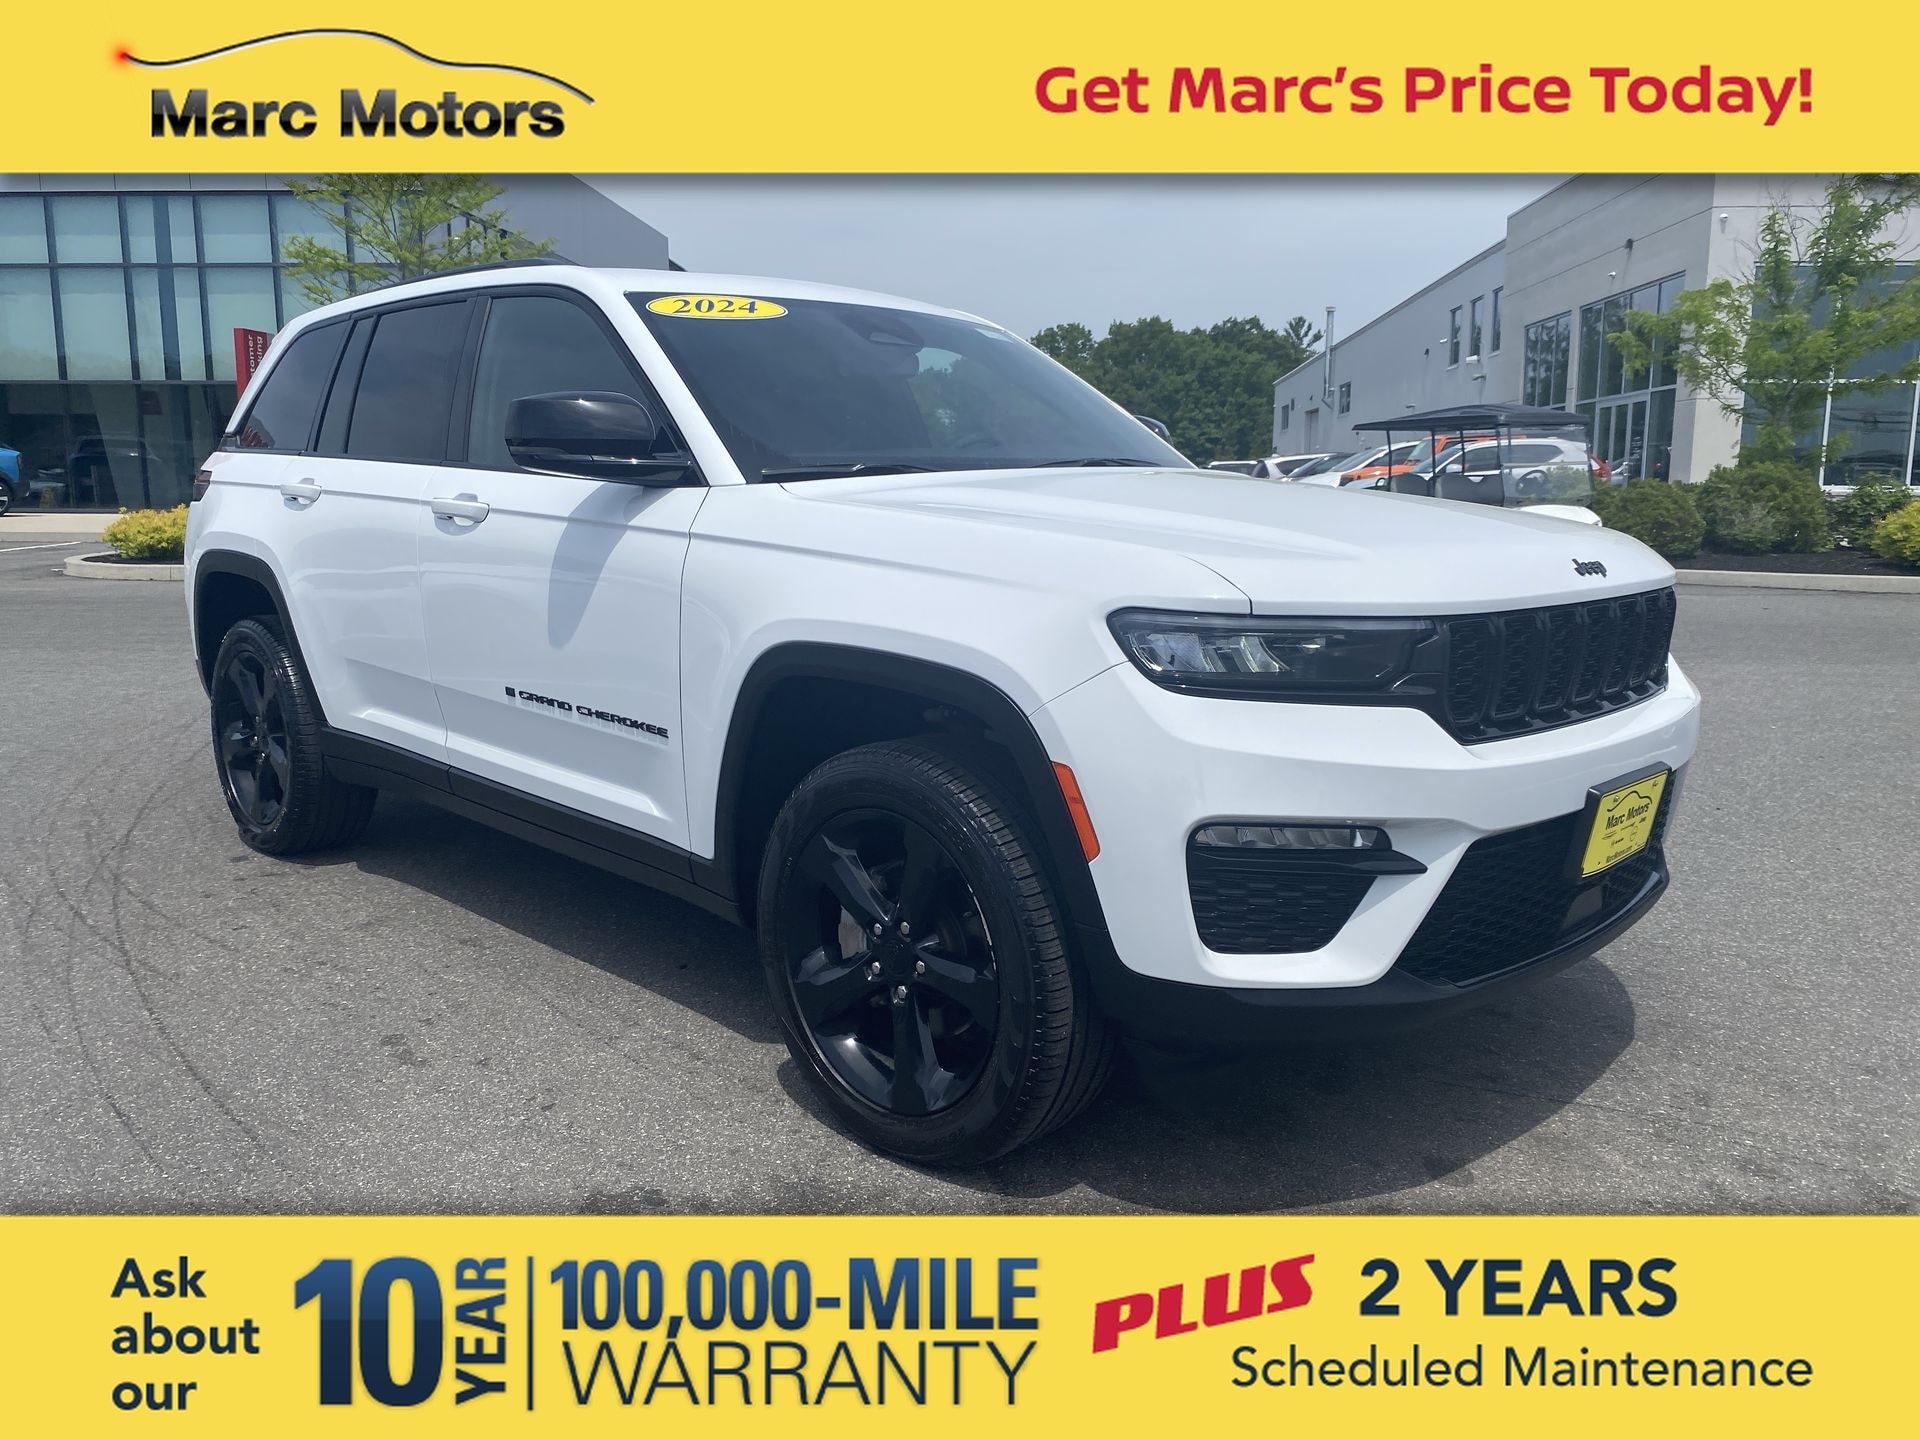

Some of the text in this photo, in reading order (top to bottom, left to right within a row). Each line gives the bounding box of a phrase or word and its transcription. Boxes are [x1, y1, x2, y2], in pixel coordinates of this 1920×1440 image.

[672, 299, 758, 314] 2024
[248, 334, 256, 375] tomer
[1572, 558, 1607, 578] Jeep
[518, 690, 669, 739] GRAND CHEROKEE
[1605, 814, 1625, 831] Marc
[1626, 803, 1650, 821] Motors
